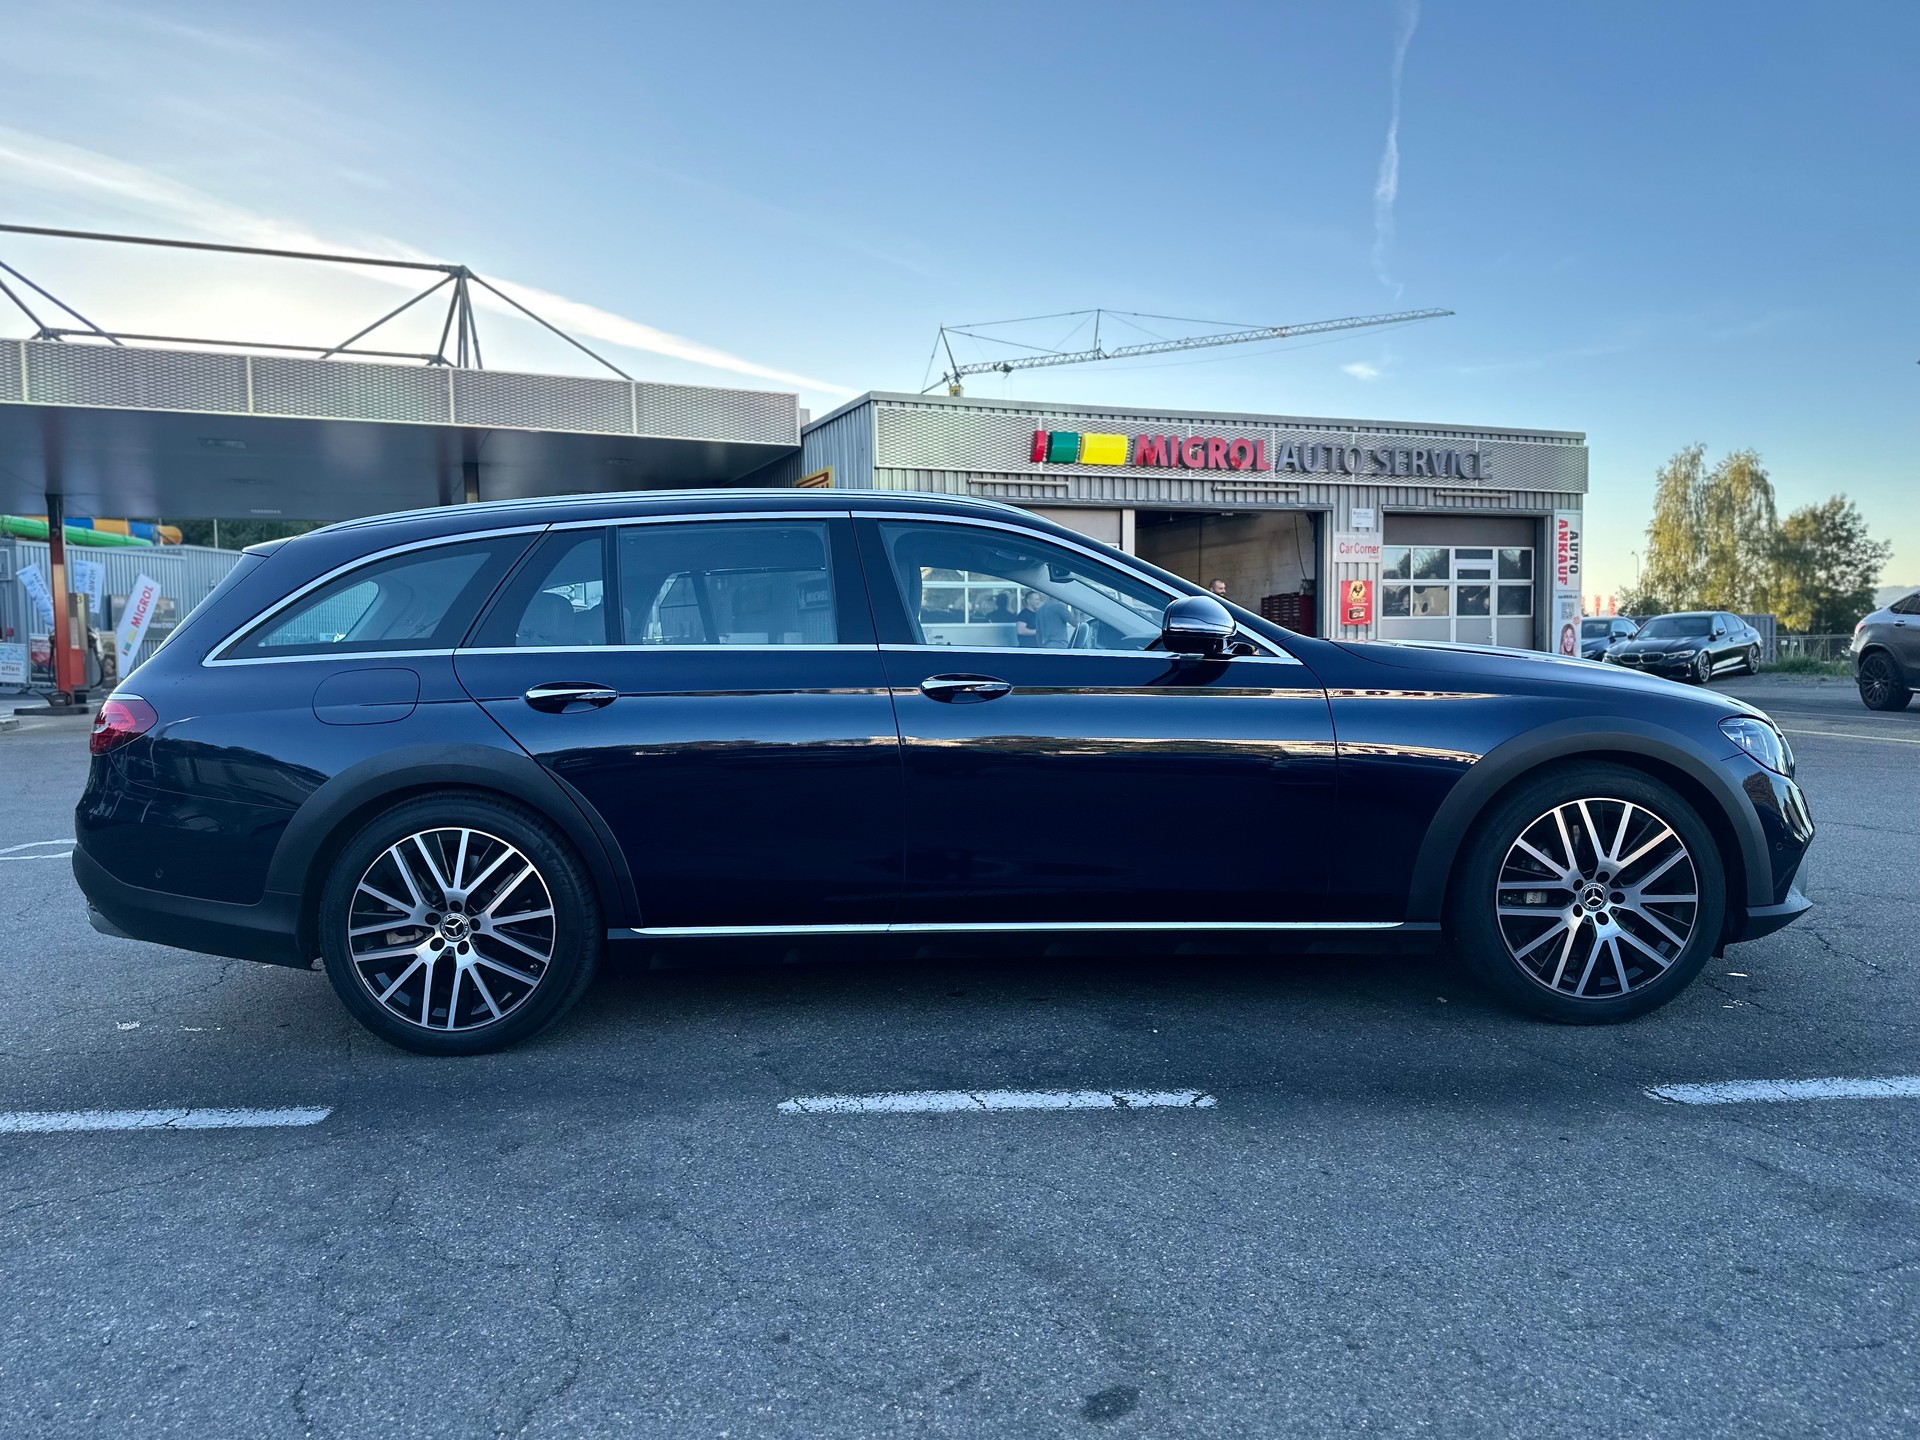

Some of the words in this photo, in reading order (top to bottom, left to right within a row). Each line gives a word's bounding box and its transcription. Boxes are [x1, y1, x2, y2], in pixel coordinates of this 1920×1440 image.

[1135, 433, 1273, 472] MIGROL
[1276, 441, 1366, 474] AUTO
[1373, 447, 1493, 480] SERVICE
[1558, 519, 1568, 585] ANKAUF
[1569, 530, 1579, 574] AUTO
[130, 586, 154, 629] MIGROL
